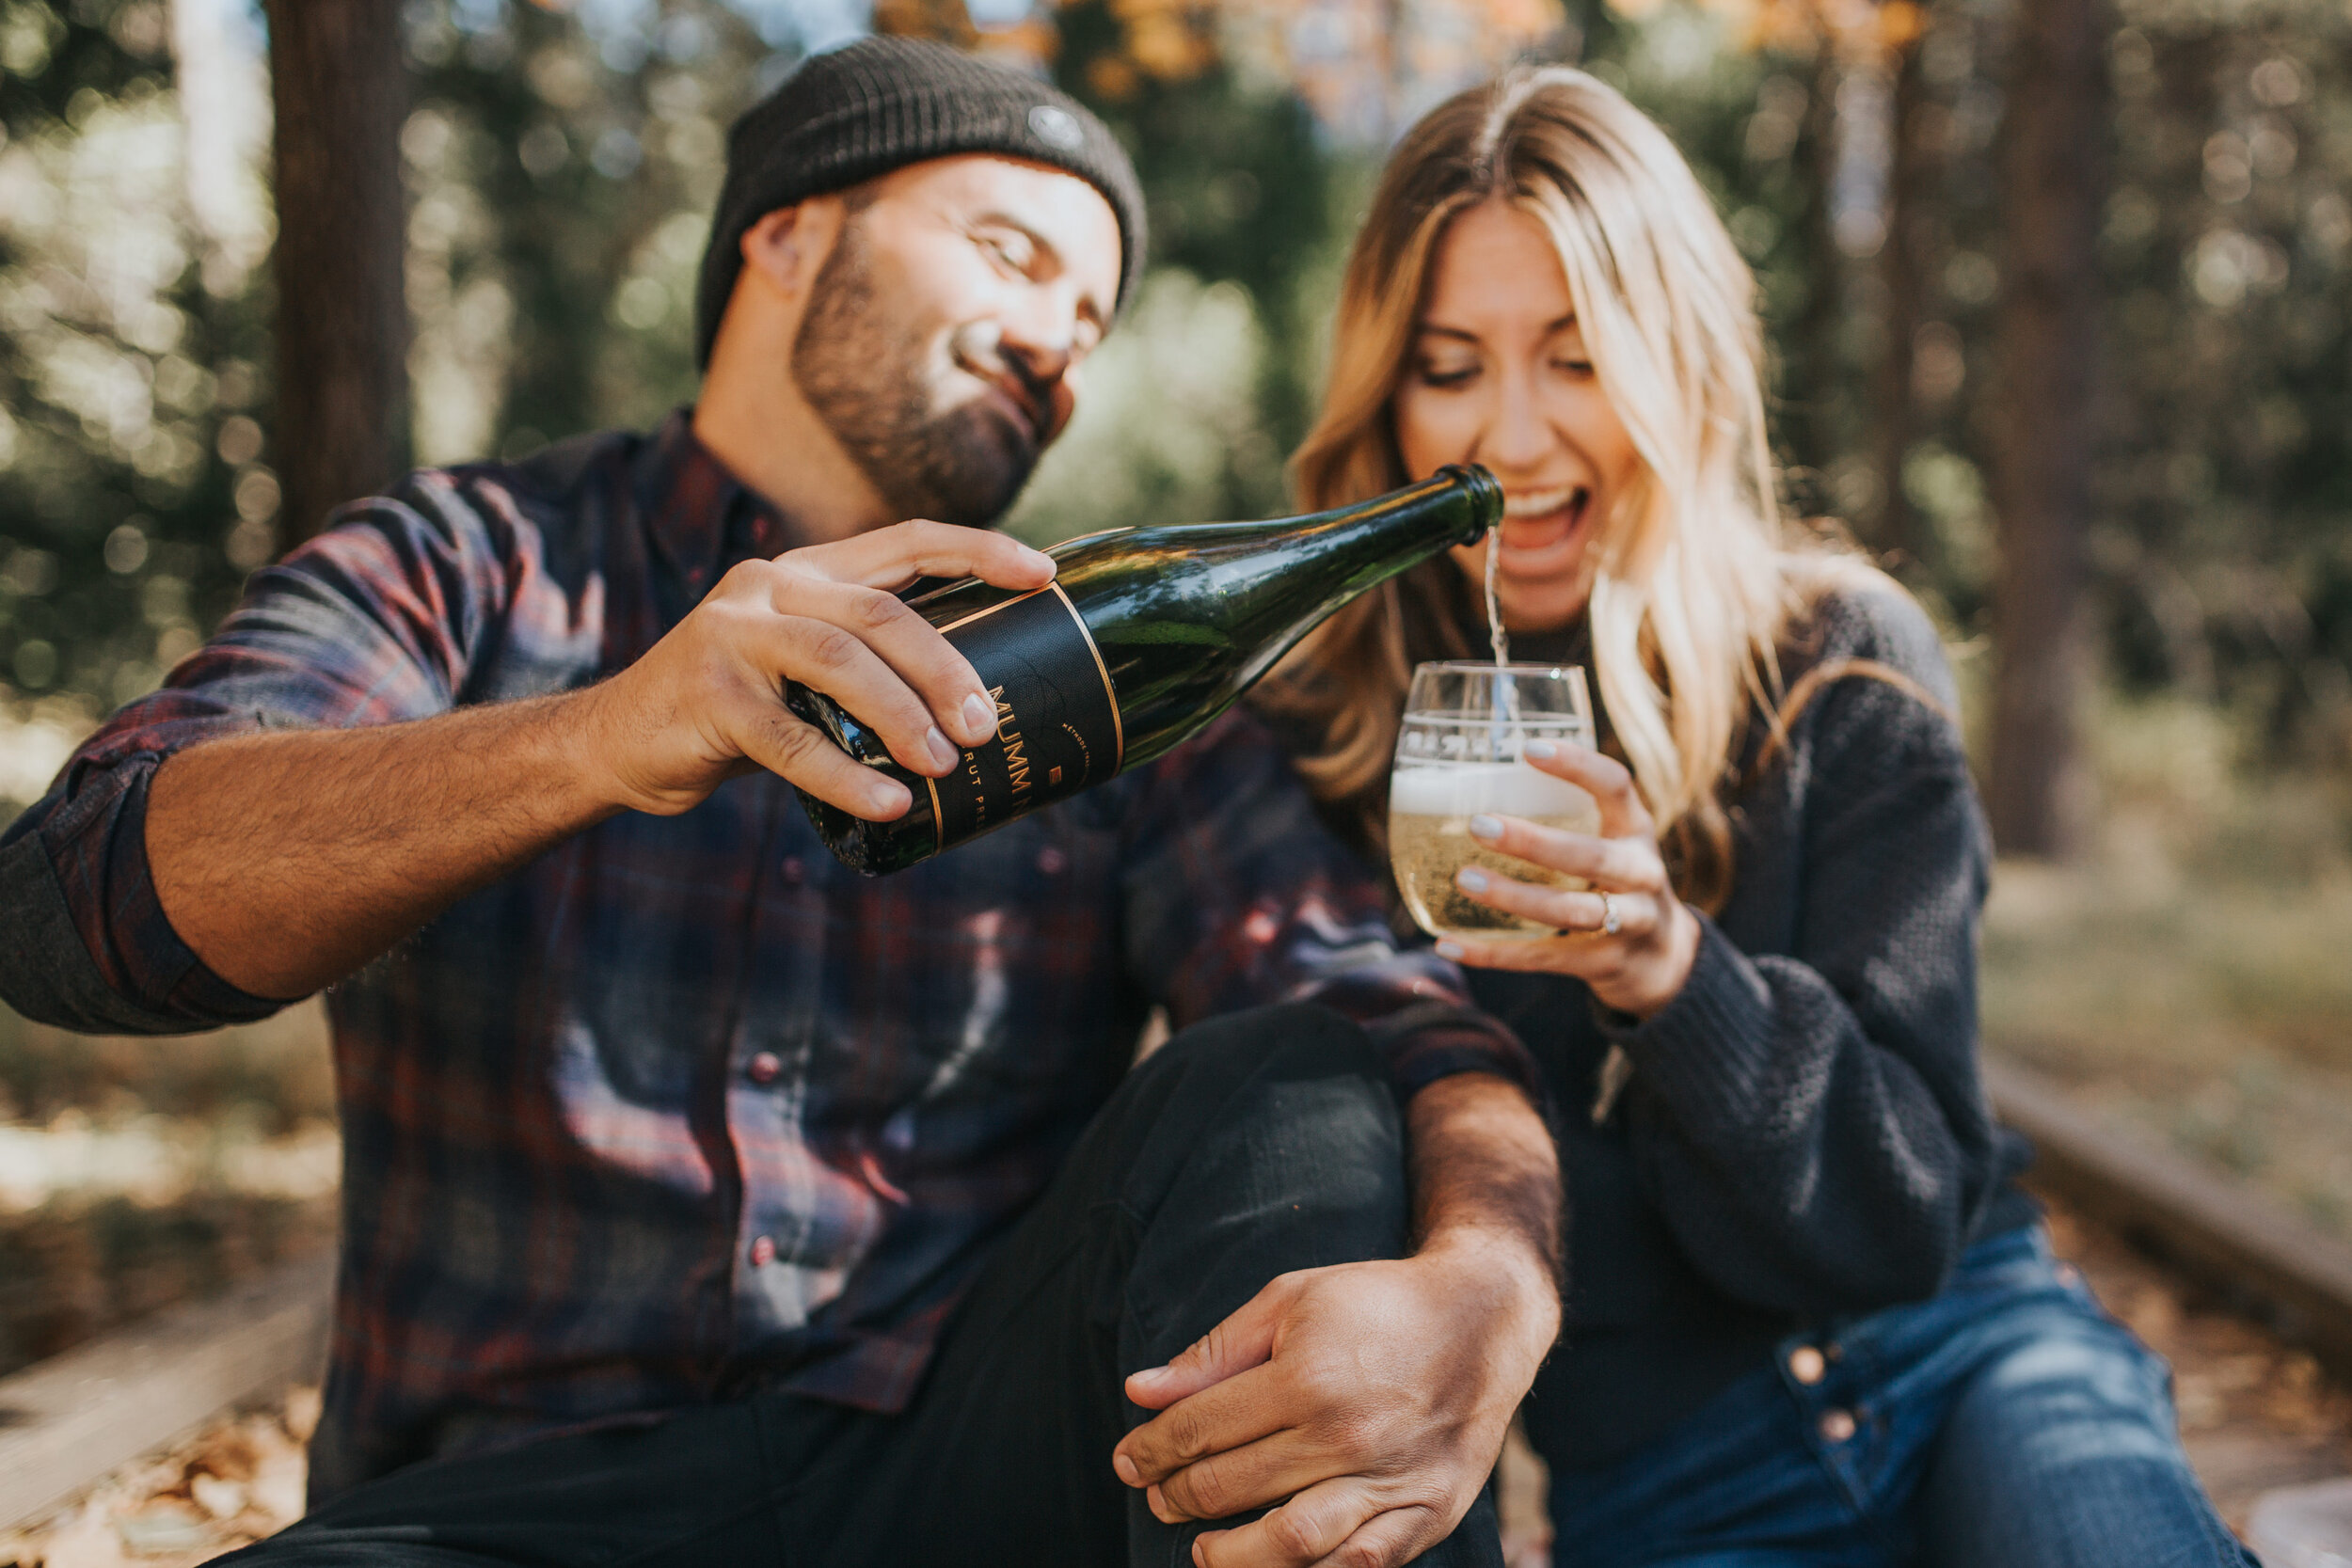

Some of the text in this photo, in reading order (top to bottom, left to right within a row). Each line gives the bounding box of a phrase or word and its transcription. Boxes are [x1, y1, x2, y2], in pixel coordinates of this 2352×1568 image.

[961, 746, 986, 828] RUT PRE
[988, 685, 1032, 795] MUMM
